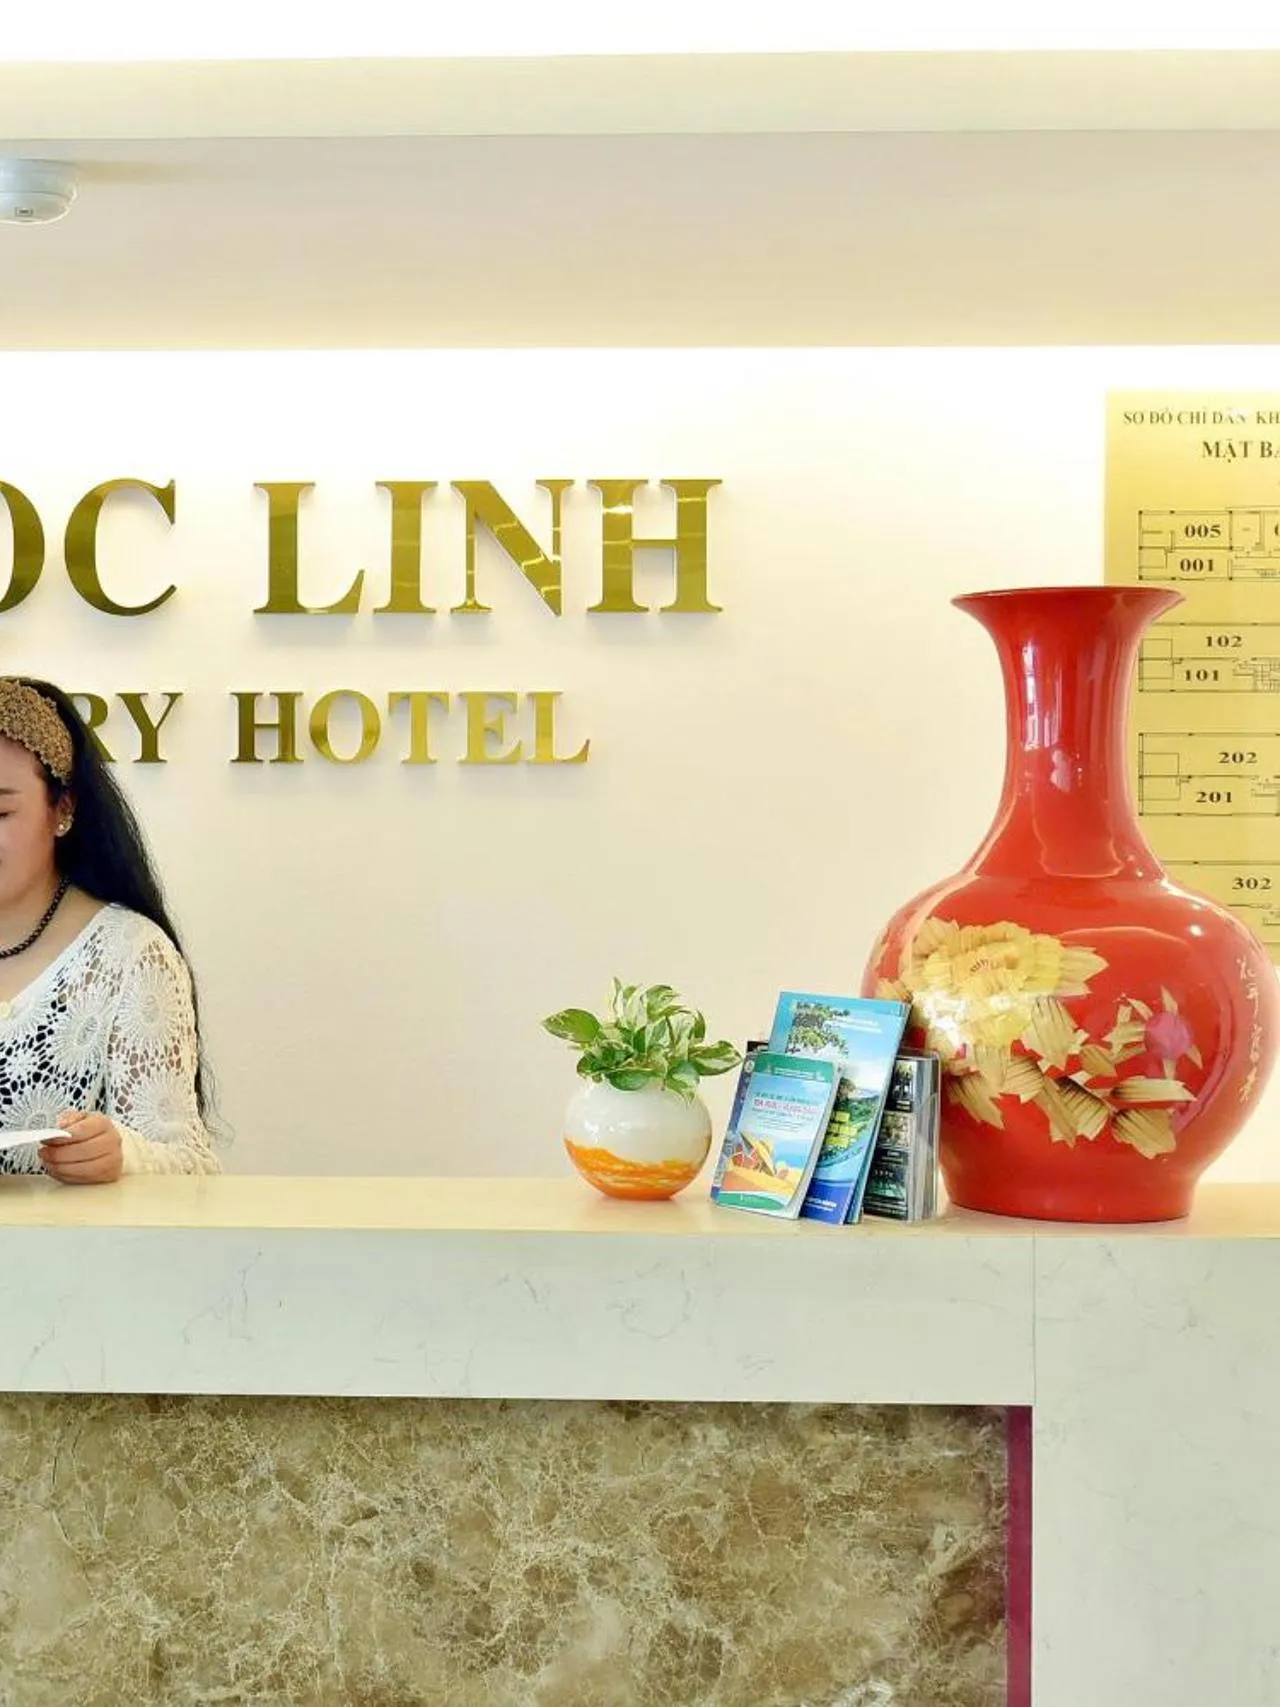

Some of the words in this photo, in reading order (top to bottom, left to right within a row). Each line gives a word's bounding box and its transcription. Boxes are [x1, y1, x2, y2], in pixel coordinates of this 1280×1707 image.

[1184, 524, 1222, 539] 005
[253, 478, 724, 617] LINH
[1179, 557, 1215, 573] 001
[1205, 635, 1243, 648] 102
[1185, 668, 1220, 682] 101
[230, 690, 591, 766] HOTEL
[1218, 751, 1258, 765] 202
[1195, 790, 1233, 804] 201
[1231, 876, 1273, 890] 302
